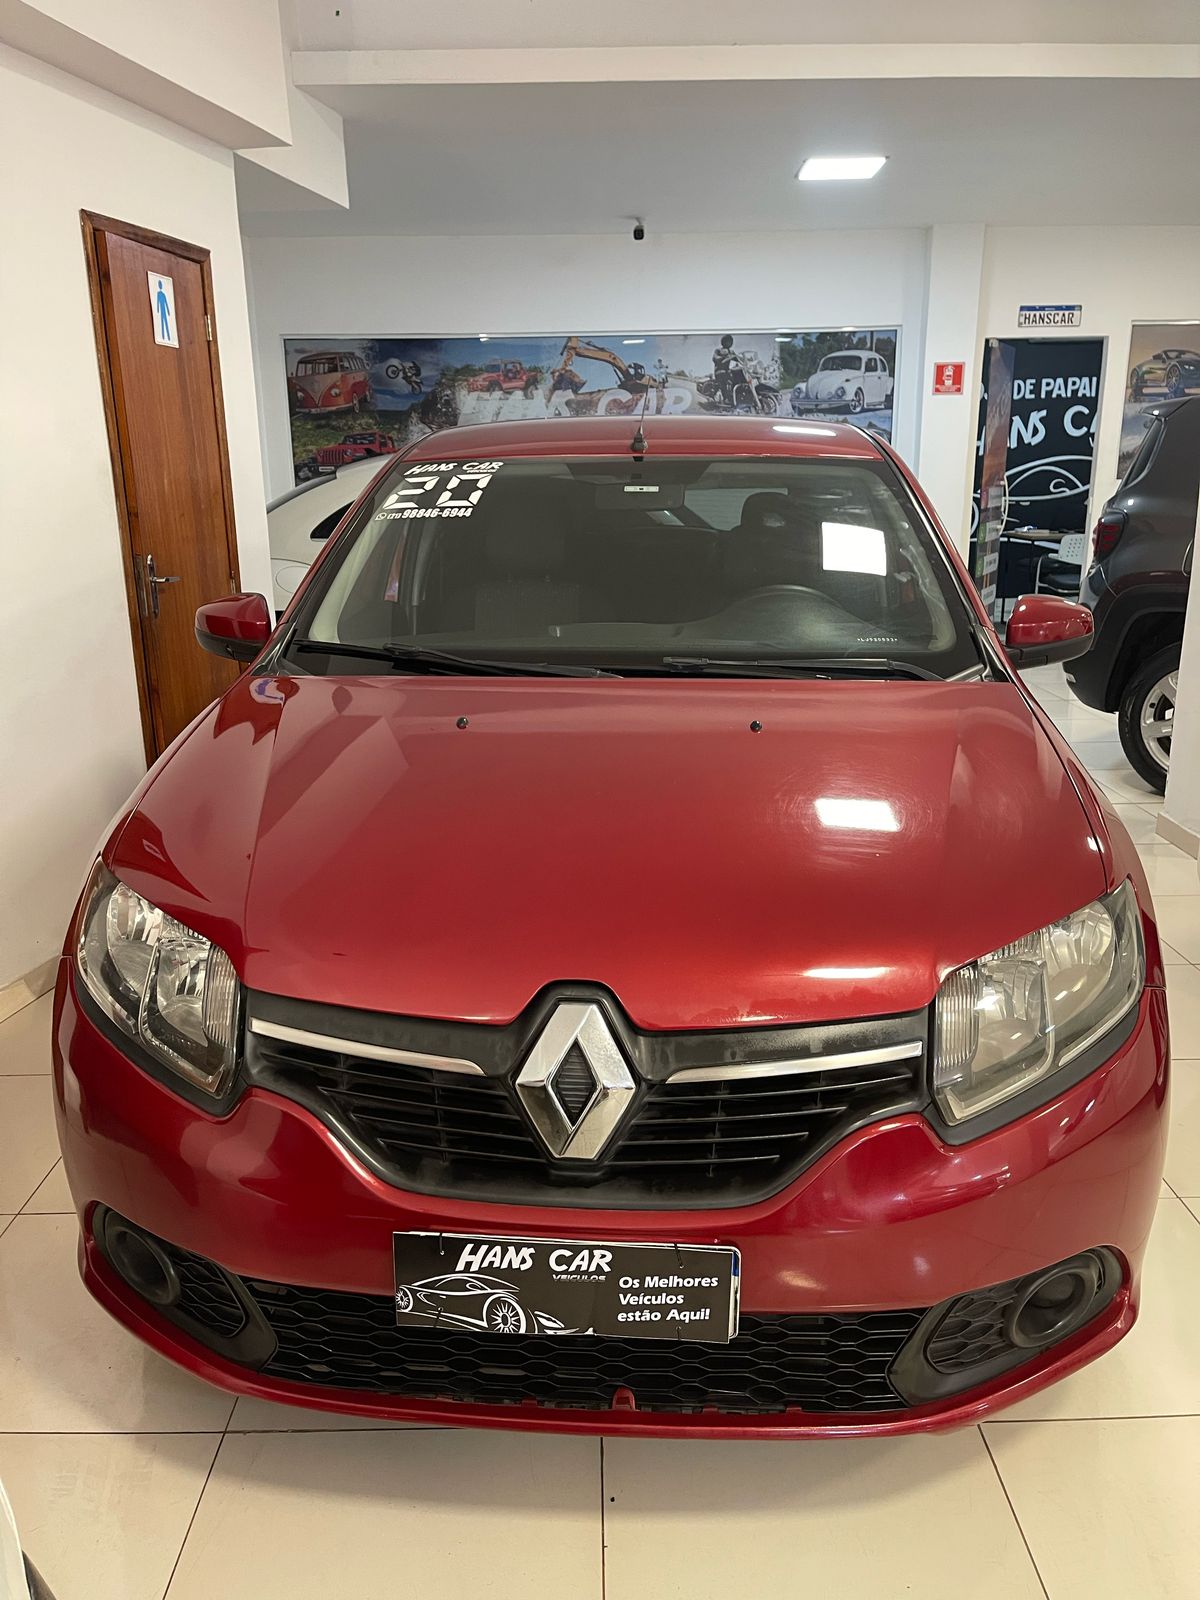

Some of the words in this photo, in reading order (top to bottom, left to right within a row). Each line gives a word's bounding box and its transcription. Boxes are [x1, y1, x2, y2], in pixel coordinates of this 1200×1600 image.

[1023, 312, 1075, 325] HANSCAR
[1013, 379, 1036, 400] DE
[1040, 376, 1097, 399] PAPAI
[403, 462, 458, 476] HANS
[462, 461, 504, 471] CAR
[382, 473, 493, 510] 20
[401, 508, 474, 519] 98846-6944
[455, 1243, 536, 1272] HANS
[549, 1249, 613, 1273] CAR
[619, 1276, 640, 1288] Os
[644, 1275, 719, 1288] Melhores
[619, 1292, 685, 1305] Veículos
[617, 1309, 662, 1322] estão
[665, 1308, 711, 1324] Aqui!
